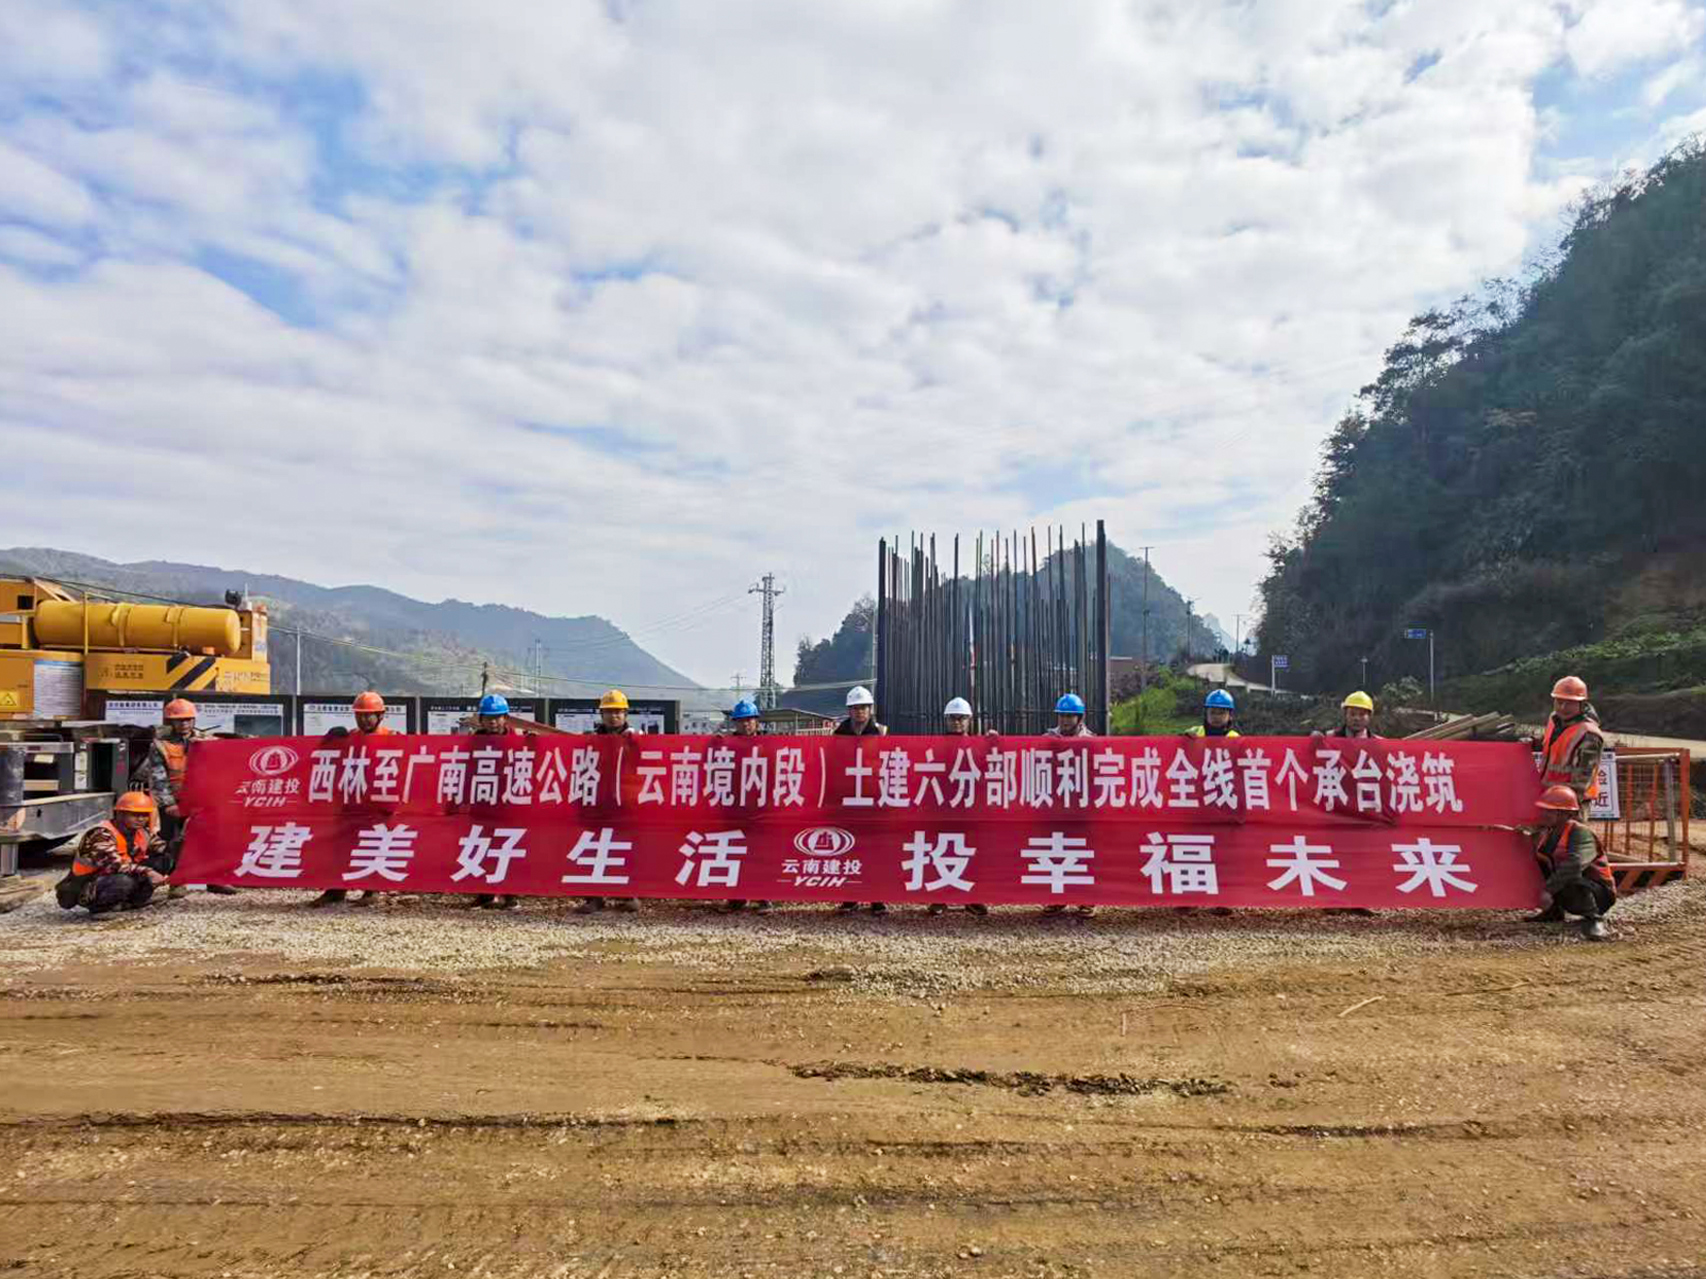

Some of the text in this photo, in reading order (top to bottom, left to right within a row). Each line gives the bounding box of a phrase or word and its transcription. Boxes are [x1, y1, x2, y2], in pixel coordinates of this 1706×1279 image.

[234, 778, 300, 795] 云南建投
[233, 822, 1478, 898] 建美好生活 投幸福未来
[781, 858, 863, 875] 云南建投
[794, 876, 847, 888] YCIH
